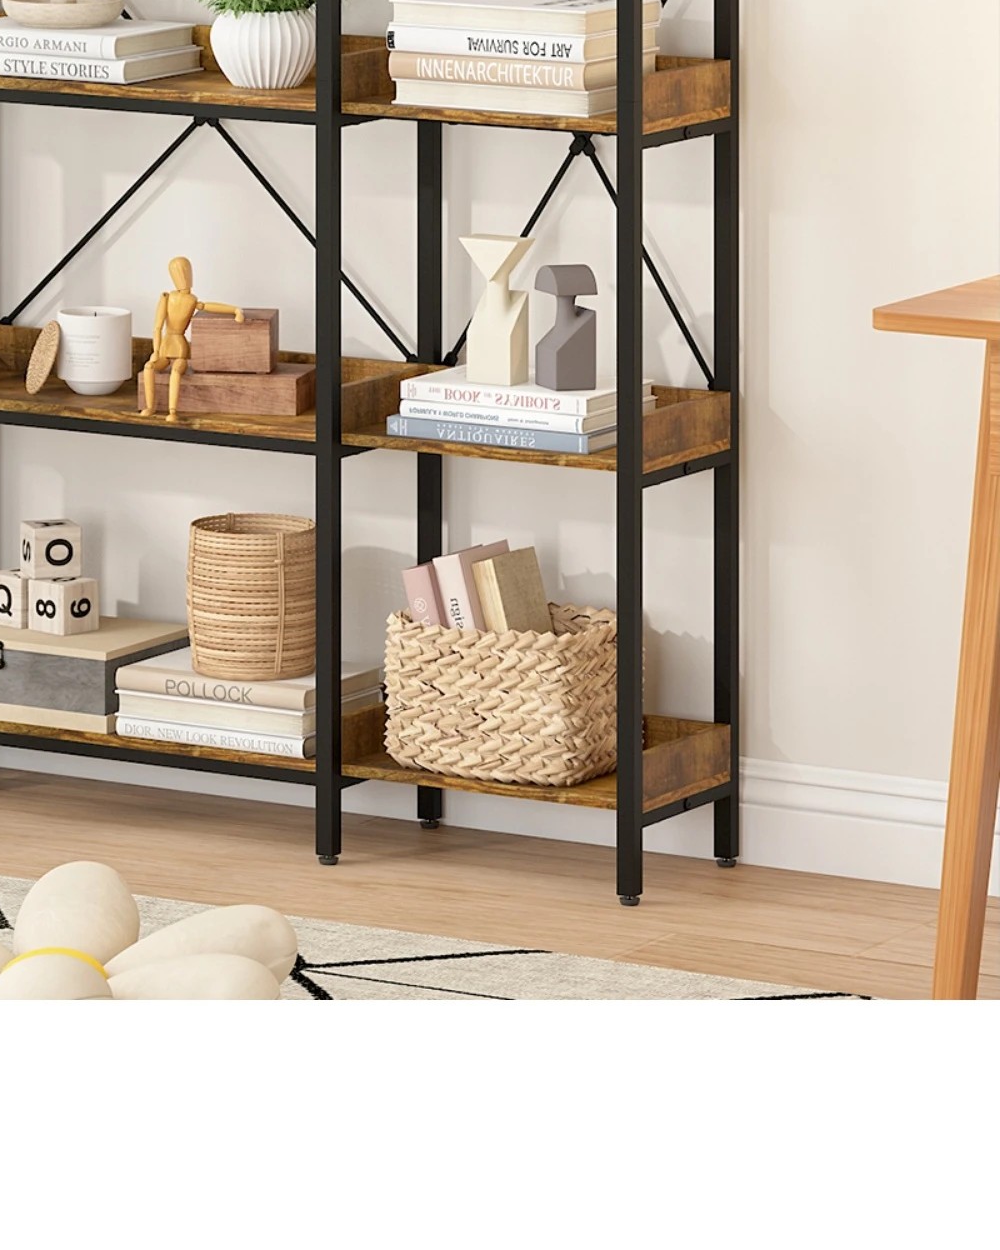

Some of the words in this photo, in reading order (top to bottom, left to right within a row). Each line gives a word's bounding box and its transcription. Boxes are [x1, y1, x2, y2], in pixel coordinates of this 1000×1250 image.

[33, 37, 87, 53] ARMANI
[467, 36, 520, 56] SURVIVAL
[522, 40, 547, 57] FOR
[550, 41, 573, 58] ART
[3, 58, 47, 76] STYLE
[50, 60, 110, 79] STORIES
[416, 57, 574, 87] INNENARCHITEKTUR
[36, 599, 56, 619] 8
[165, 679, 253, 703] POLLOCK
[157, 727, 183, 740] NEW
[186, 731, 218, 745] LOOK
[220, 734, 294, 754] REVOLUTION
